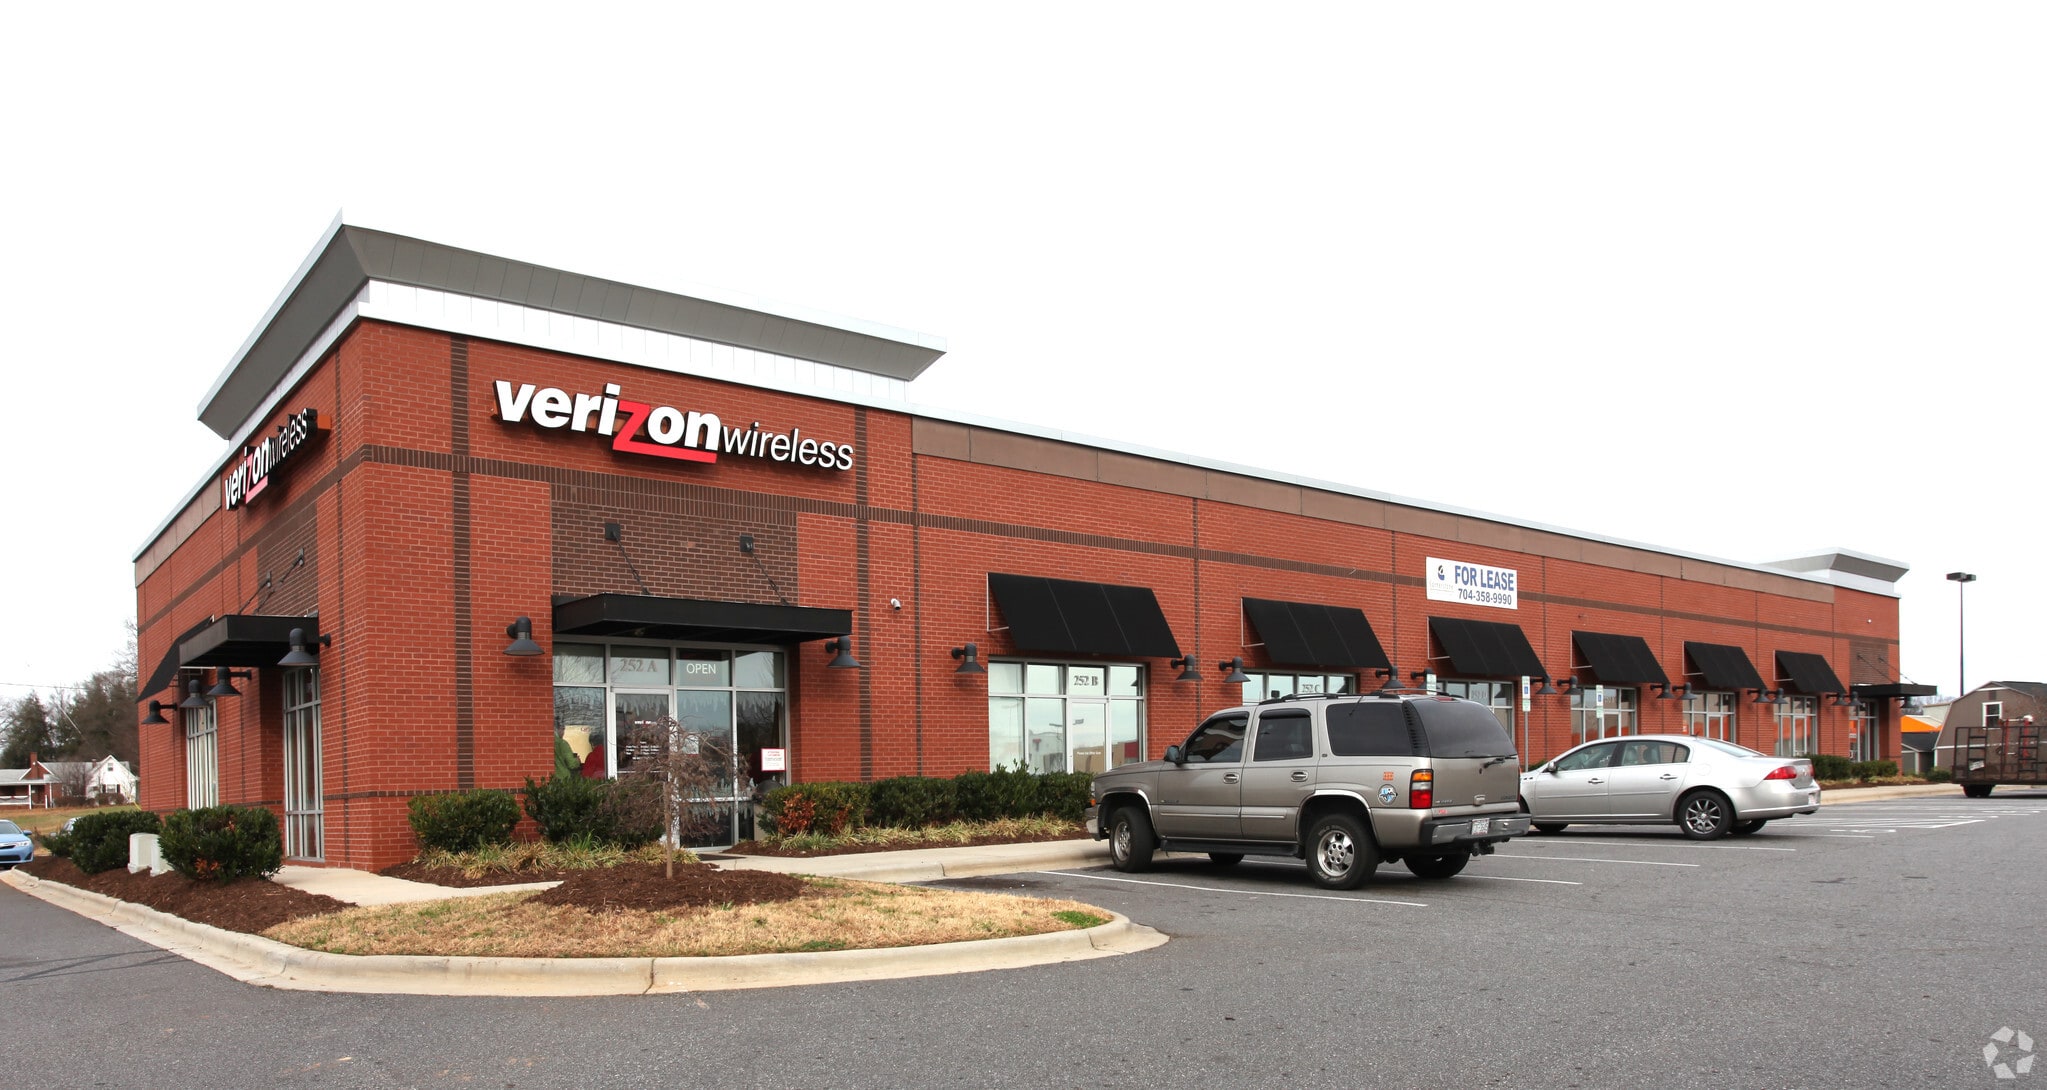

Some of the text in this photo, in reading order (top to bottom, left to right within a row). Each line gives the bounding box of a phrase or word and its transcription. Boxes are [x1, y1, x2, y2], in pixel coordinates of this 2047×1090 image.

[494, 379, 854, 471] verizon wireless
[224, 407, 308, 510] verizon wireless
[1454, 565, 1515, 591] FOR LEASE
[1458, 588, 1512, 605] 704-358-9990
[619, 658, 658, 673] 252 A
[686, 663, 717, 675] OPEN
[1073, 675, 1099, 686] 252 B
[1302, 684, 1314, 693] 252
